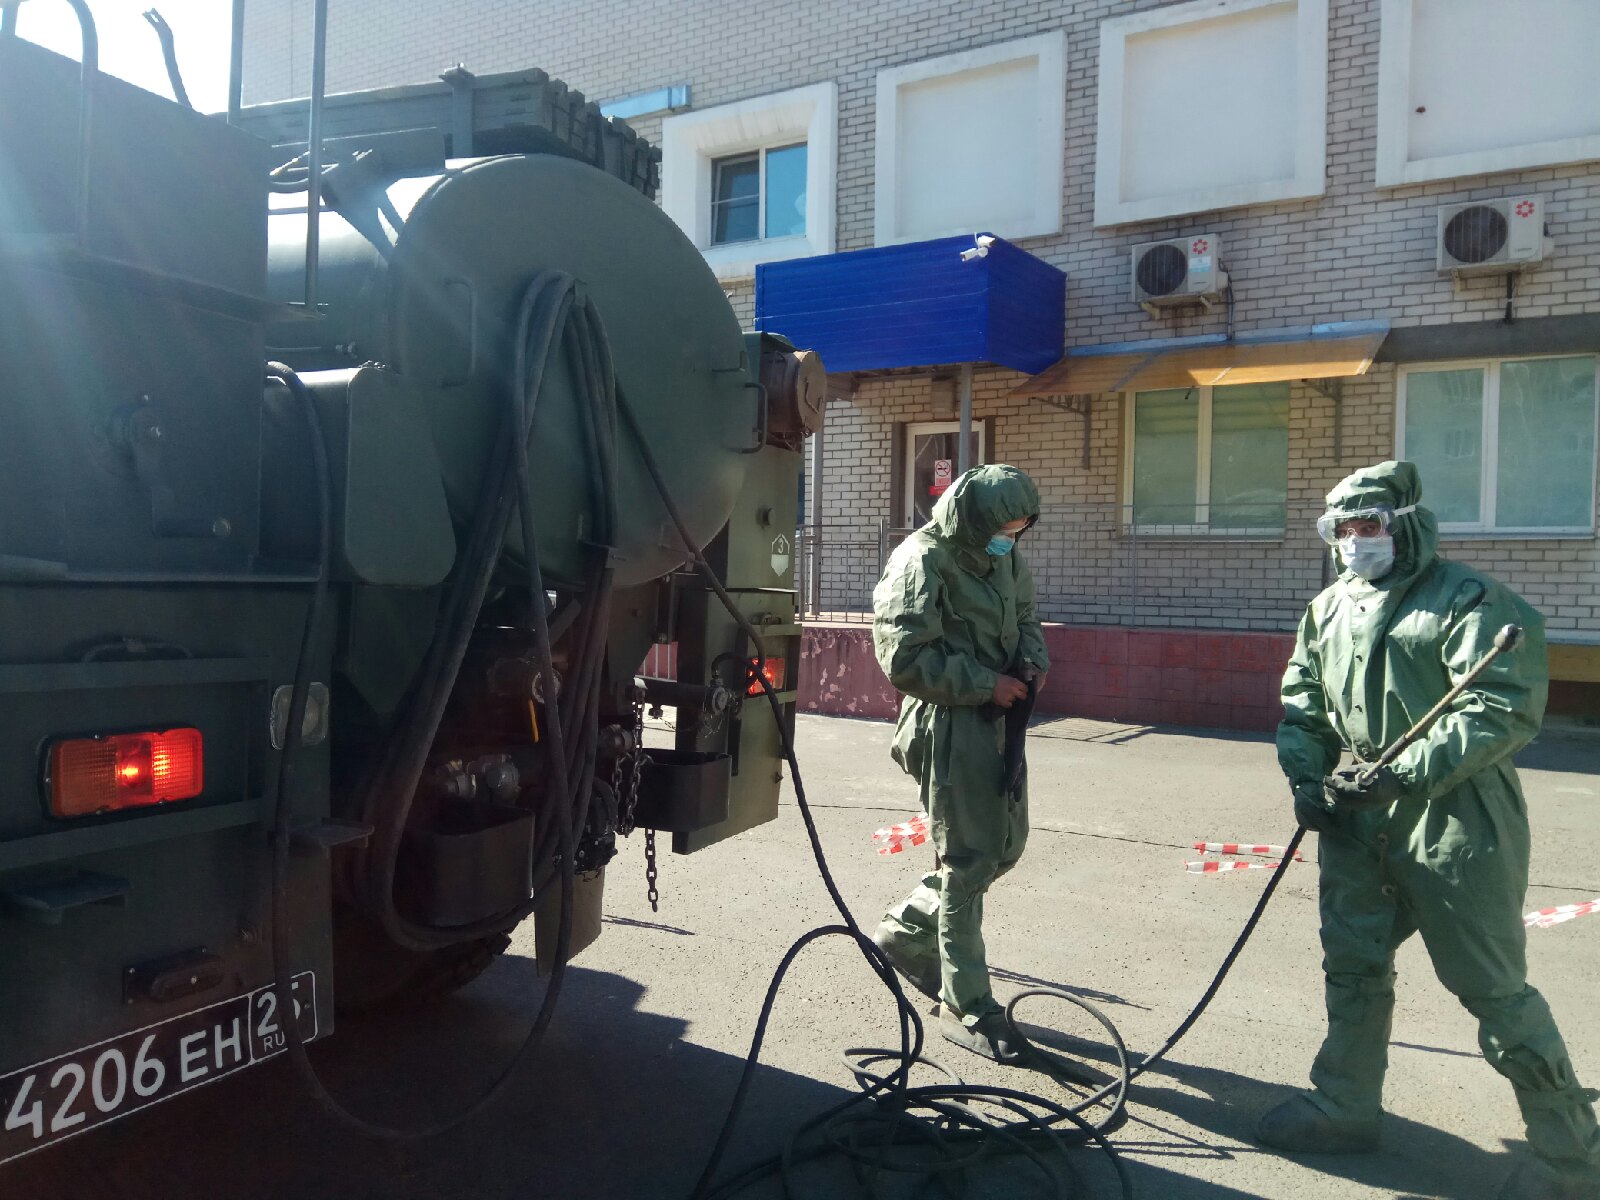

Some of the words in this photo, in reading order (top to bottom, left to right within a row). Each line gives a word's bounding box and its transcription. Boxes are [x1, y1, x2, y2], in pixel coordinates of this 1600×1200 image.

[777, 537, 784, 554] 3
[263, 1032, 286, 1052] RU
[5, 1034, 166, 1138] 4206
